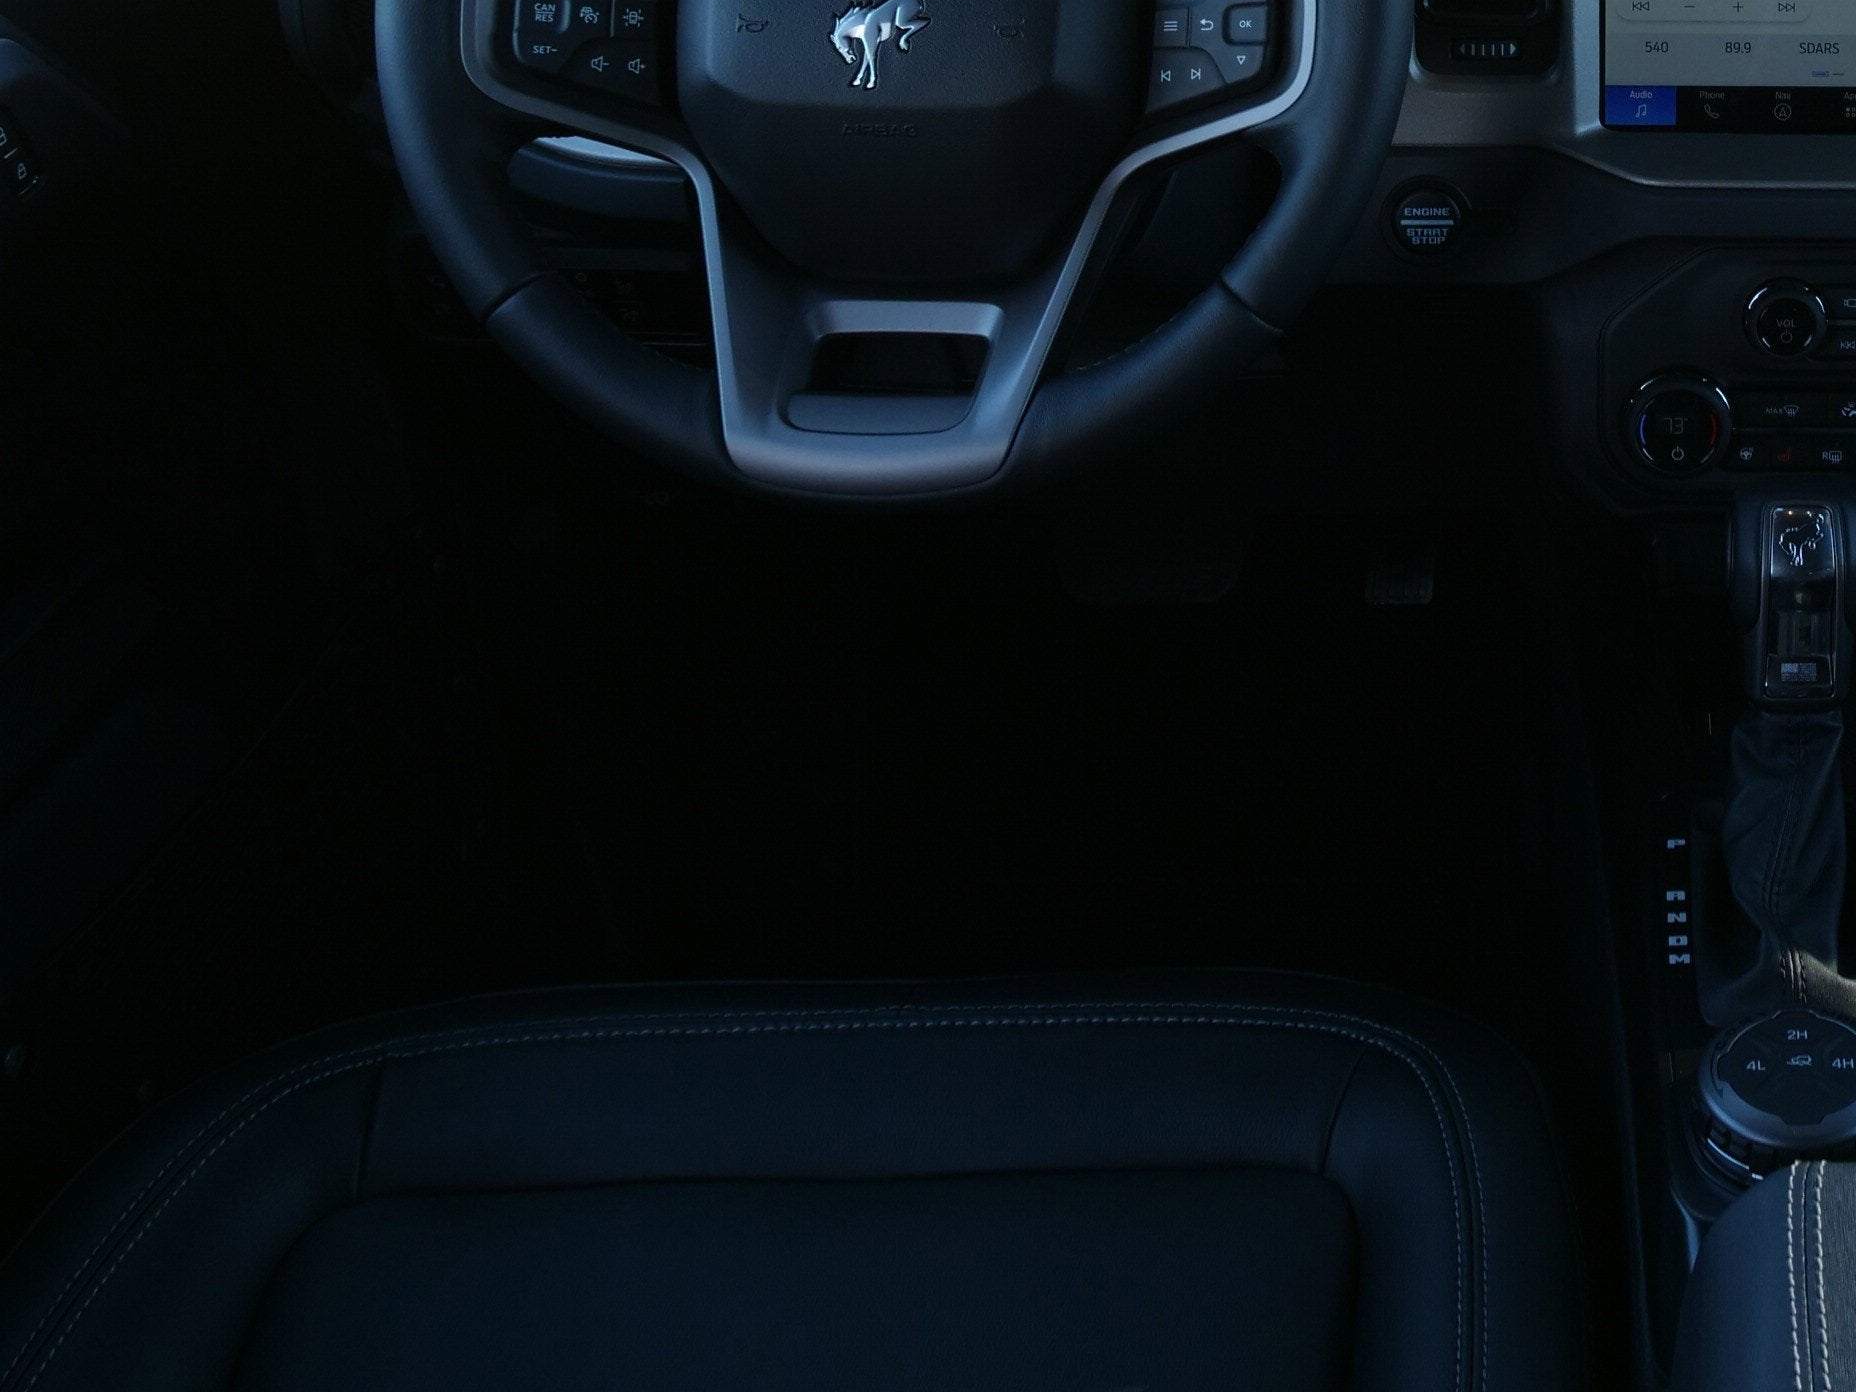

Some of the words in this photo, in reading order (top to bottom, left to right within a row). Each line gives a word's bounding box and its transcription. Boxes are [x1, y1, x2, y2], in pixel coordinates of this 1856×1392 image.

[534, 3, 556, 12] CAN
[535, 13, 553, 22] RES
[1239, 20, 1251, 28] OK
[1645, 41, 1669, 53] 540
[1725, 42, 1751, 54] 89.9
[1799, 43, 1840, 54] SDARS
[1629, 90, 1652, 99] Audio
[1700, 91, 1725, 100] Phone
[1775, 91, 1791, 100] Nav
[1404, 208, 1450, 216] ENGINE
[1406, 228, 1449, 236] START
[1411, 236, 1446, 244] STOP
[1776, 319, 1795, 327] VOL
[1667, 912, 1687, 923] N
[1668, 953, 1691, 965] M
[1787, 1029, 1808, 1040] 2H
[1746, 1060, 1766, 1071] 4L
[1832, 1057, 1854, 1069] 4H
